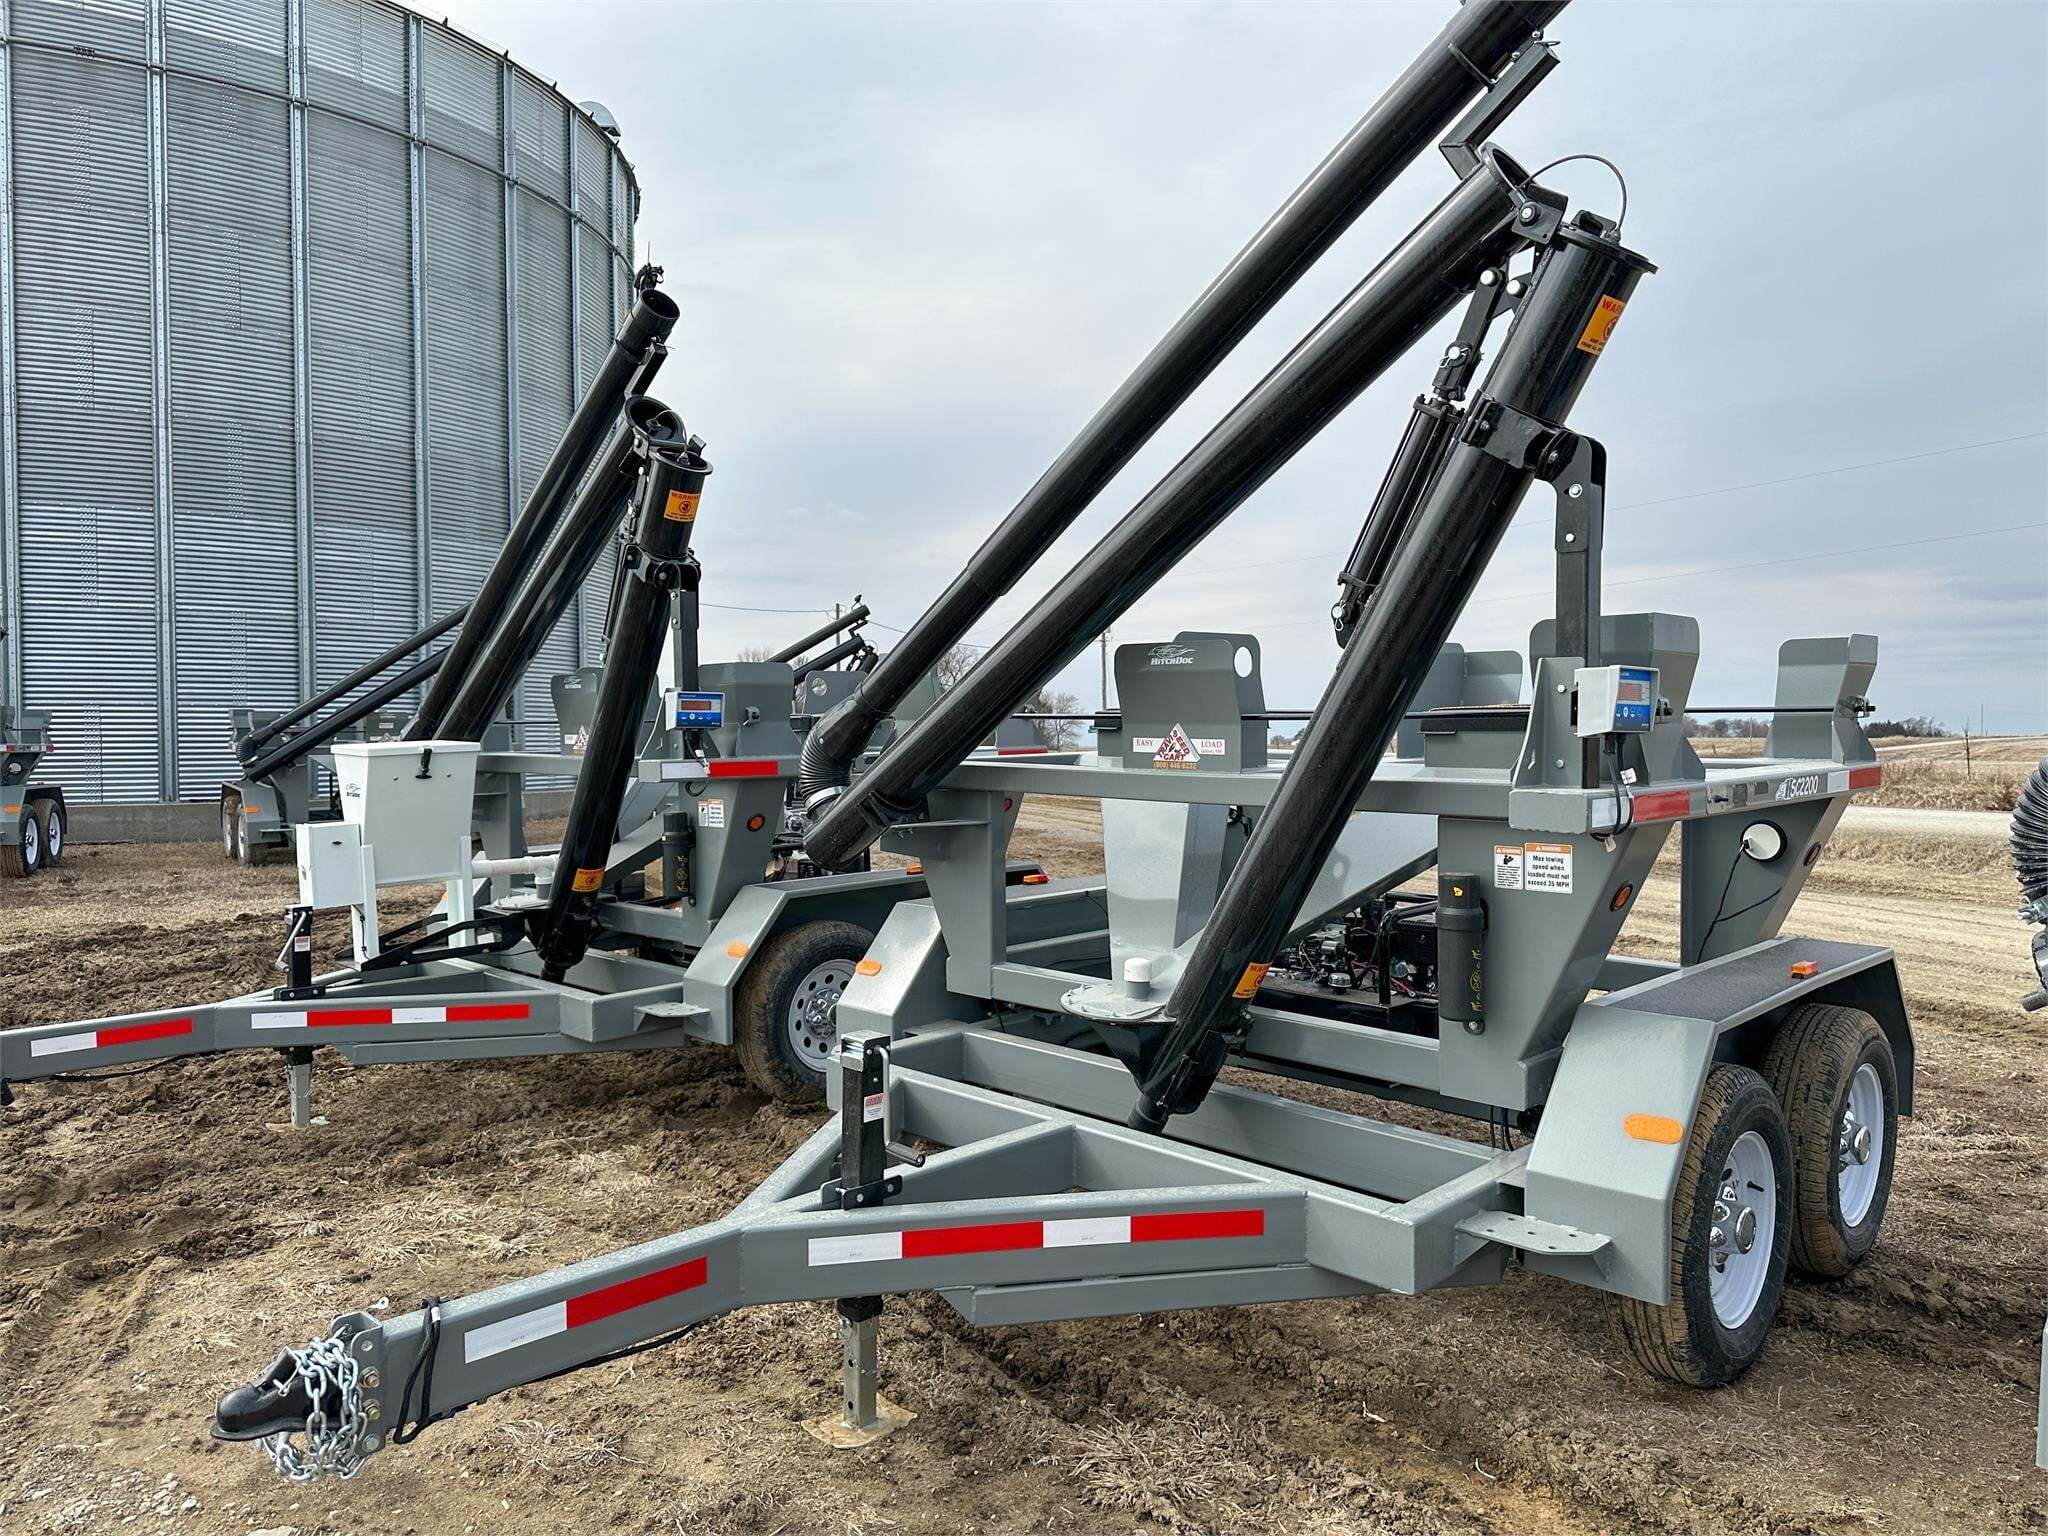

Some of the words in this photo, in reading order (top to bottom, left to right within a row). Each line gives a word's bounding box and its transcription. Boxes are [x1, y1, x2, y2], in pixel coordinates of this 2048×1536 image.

[1136, 739, 1153, 747] EASY
[1200, 740, 1223, 748] LOAD
[1546, 856, 1563, 864] towing
